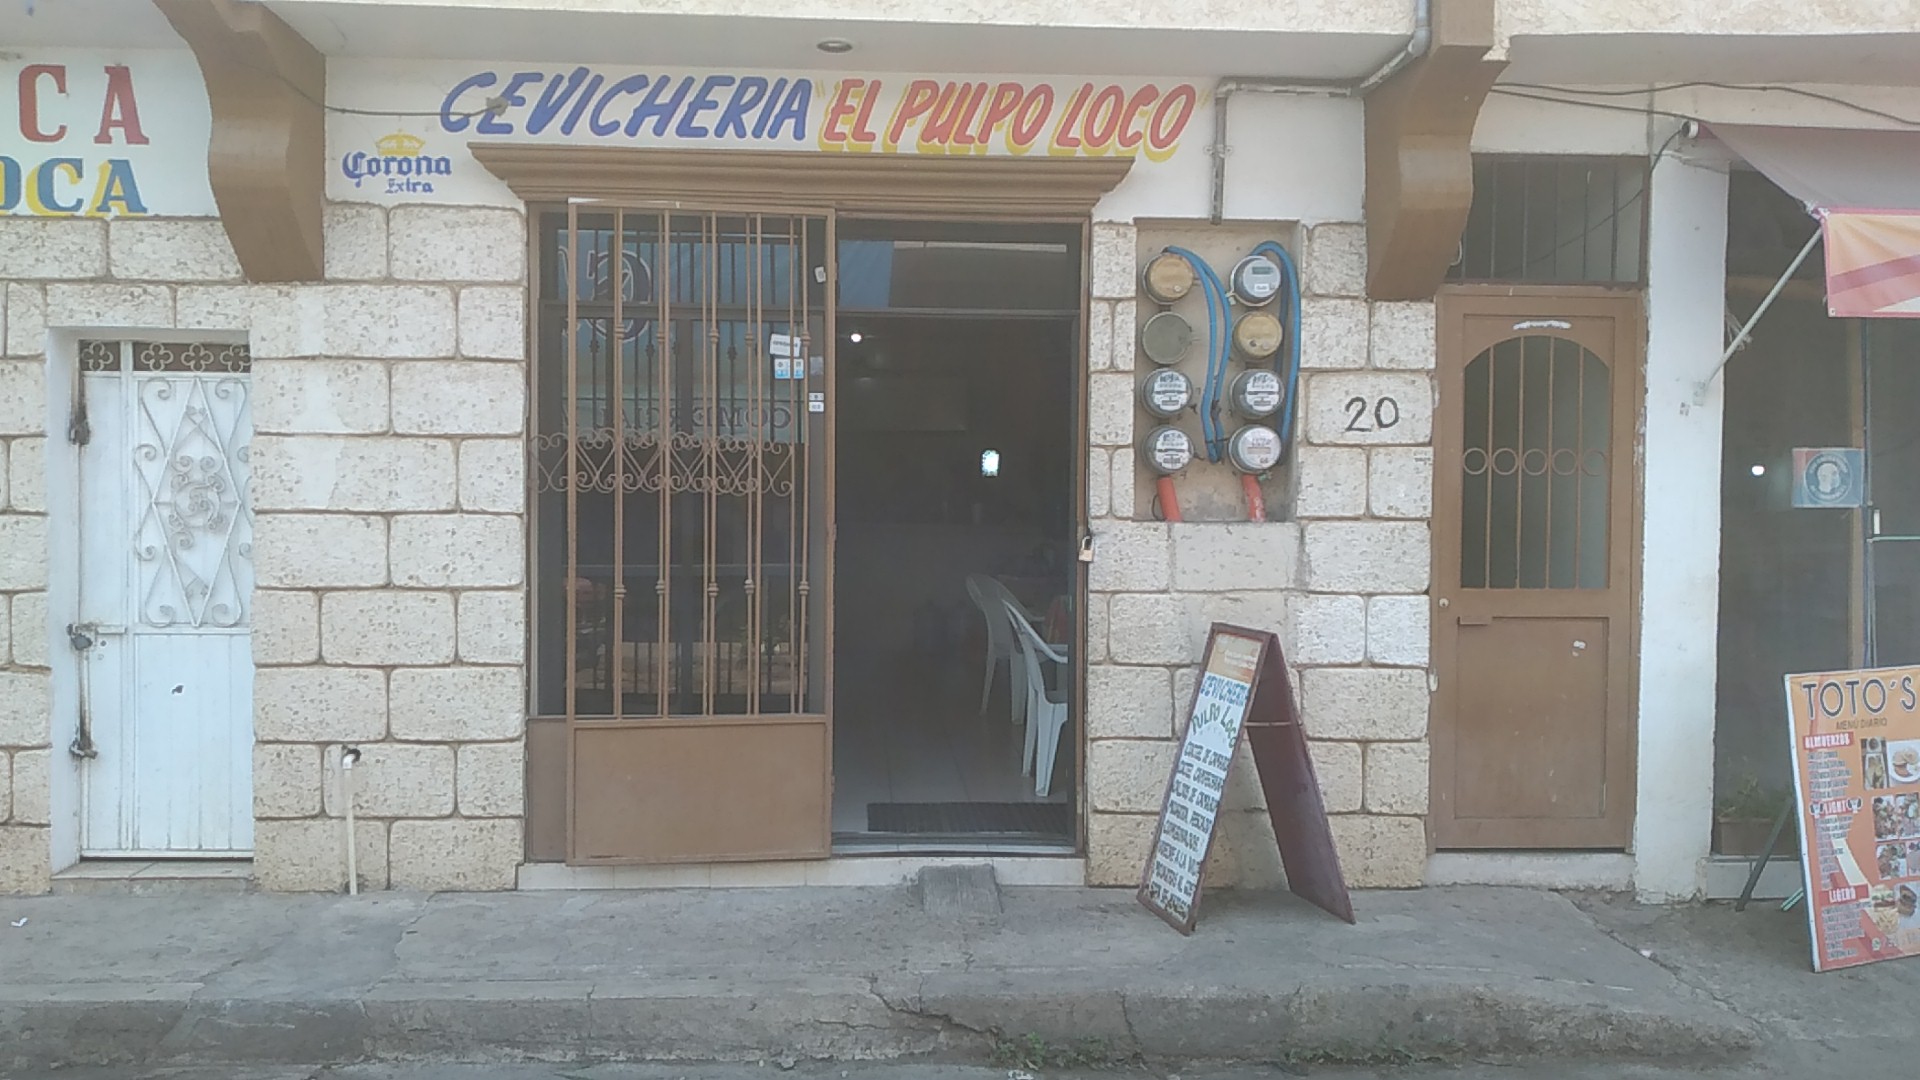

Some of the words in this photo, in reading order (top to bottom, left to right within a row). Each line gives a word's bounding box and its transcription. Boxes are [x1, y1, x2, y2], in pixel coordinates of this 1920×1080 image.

[440, 66, 813, 141] CEVICHERIA
[879, 79, 1055, 156] PULPO
[1047, 82, 1197, 162] LOCO
[342, 151, 452, 188] Corona
[385, 177, 434, 194] Extra
[1344, 396, 1400, 432] 20
